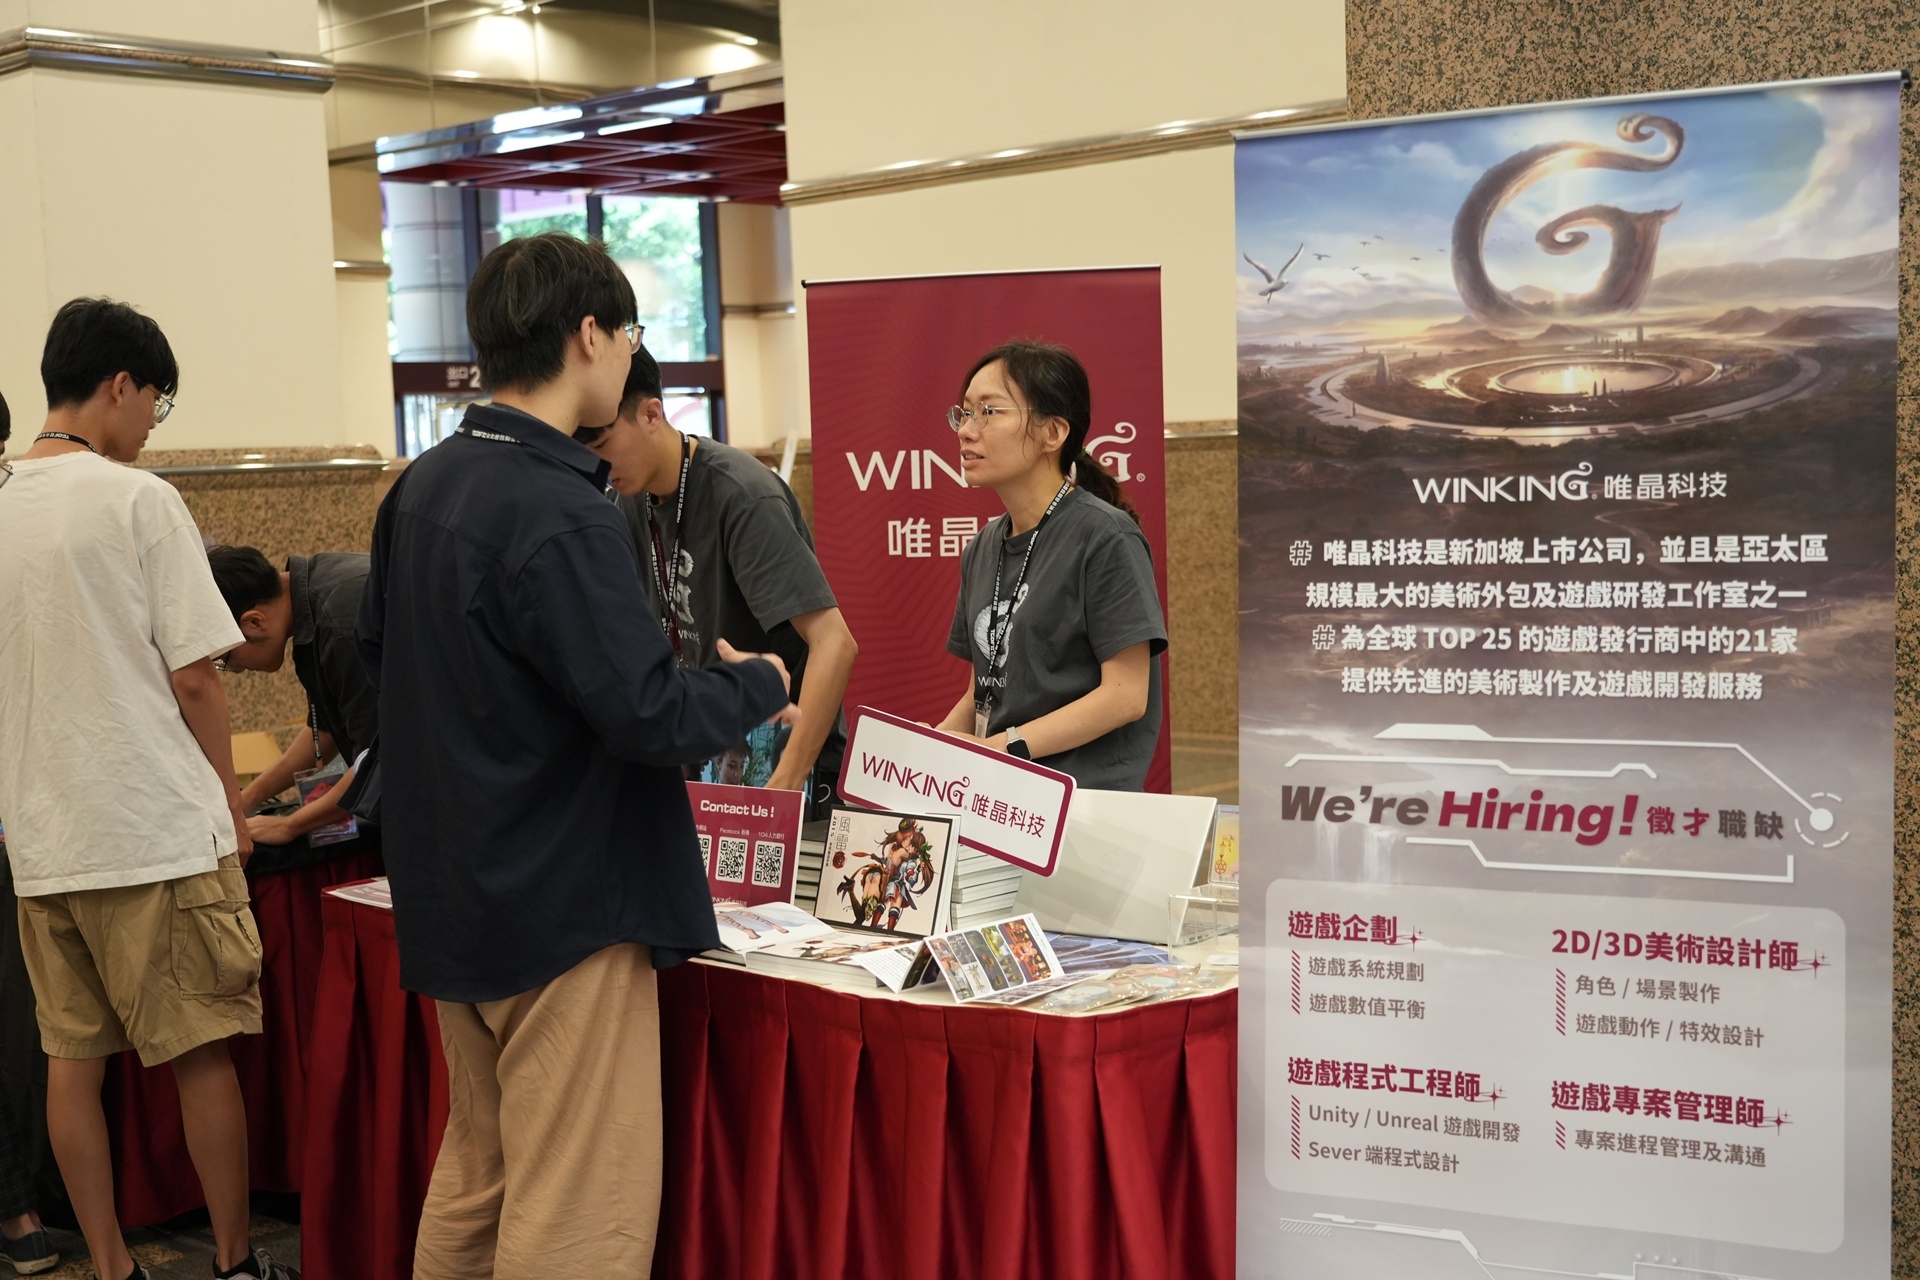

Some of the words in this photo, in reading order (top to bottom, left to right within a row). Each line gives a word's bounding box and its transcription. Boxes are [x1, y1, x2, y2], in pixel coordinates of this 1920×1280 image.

[845, 422, 1138, 491] WING
[1412, 461, 1593, 503] WINKING
[1604, 472, 1727, 500] 唯晶科技
[1306, 580, 1807, 609] 規模最大的美術外包及遊戲研發工作室之一
[1341, 624, 1417, 651] 為全球
[1423, 627, 1476, 649] TOP
[1482, 627, 1511, 650] 25
[1519, 625, 1798, 654] 的遊戲發行商中的21家
[1341, 667, 1763, 700] 提供先進的美術製作及遊戲開發服務
[700, 800, 749, 815] Contact
[862, 752, 970, 808] WINKING
[971, 793, 1046, 838] 唯晶科技
[1281, 785, 1429, 826] We're
[1438, 788, 1640, 846] Hiring!
[1288, 910, 1398, 944] 遊戲企劃
[1551, 929, 1799, 971] 2D/3D美術設計師
[1308, 956, 1424, 982] 遊戲系統規劃
[1309, 993, 1425, 1020] 遊戲數值平衡
[1575, 974, 1616, 996] 角色
[1636, 978, 1720, 1004] 場景製作
[1575, 1013, 1660, 1039] 遊戲動作
[1680, 1020, 1764, 1048] 特效設計
[1287, 1056, 1481, 1101] 遊戲程式工程師
[1551, 1080, 1765, 1127] 遊戲專案管理師
[1309, 1104, 1359, 1128] Unity
[1377, 1110, 1438, 1132] Unreal
[1443, 1115, 1521, 1143] 遊戲開發
[1309, 1141, 1362, 1161] Sever
[1365, 1145, 1460, 1174] 端程式設計
[1575, 1129, 1766, 1168] 專案進程管理及溝通
